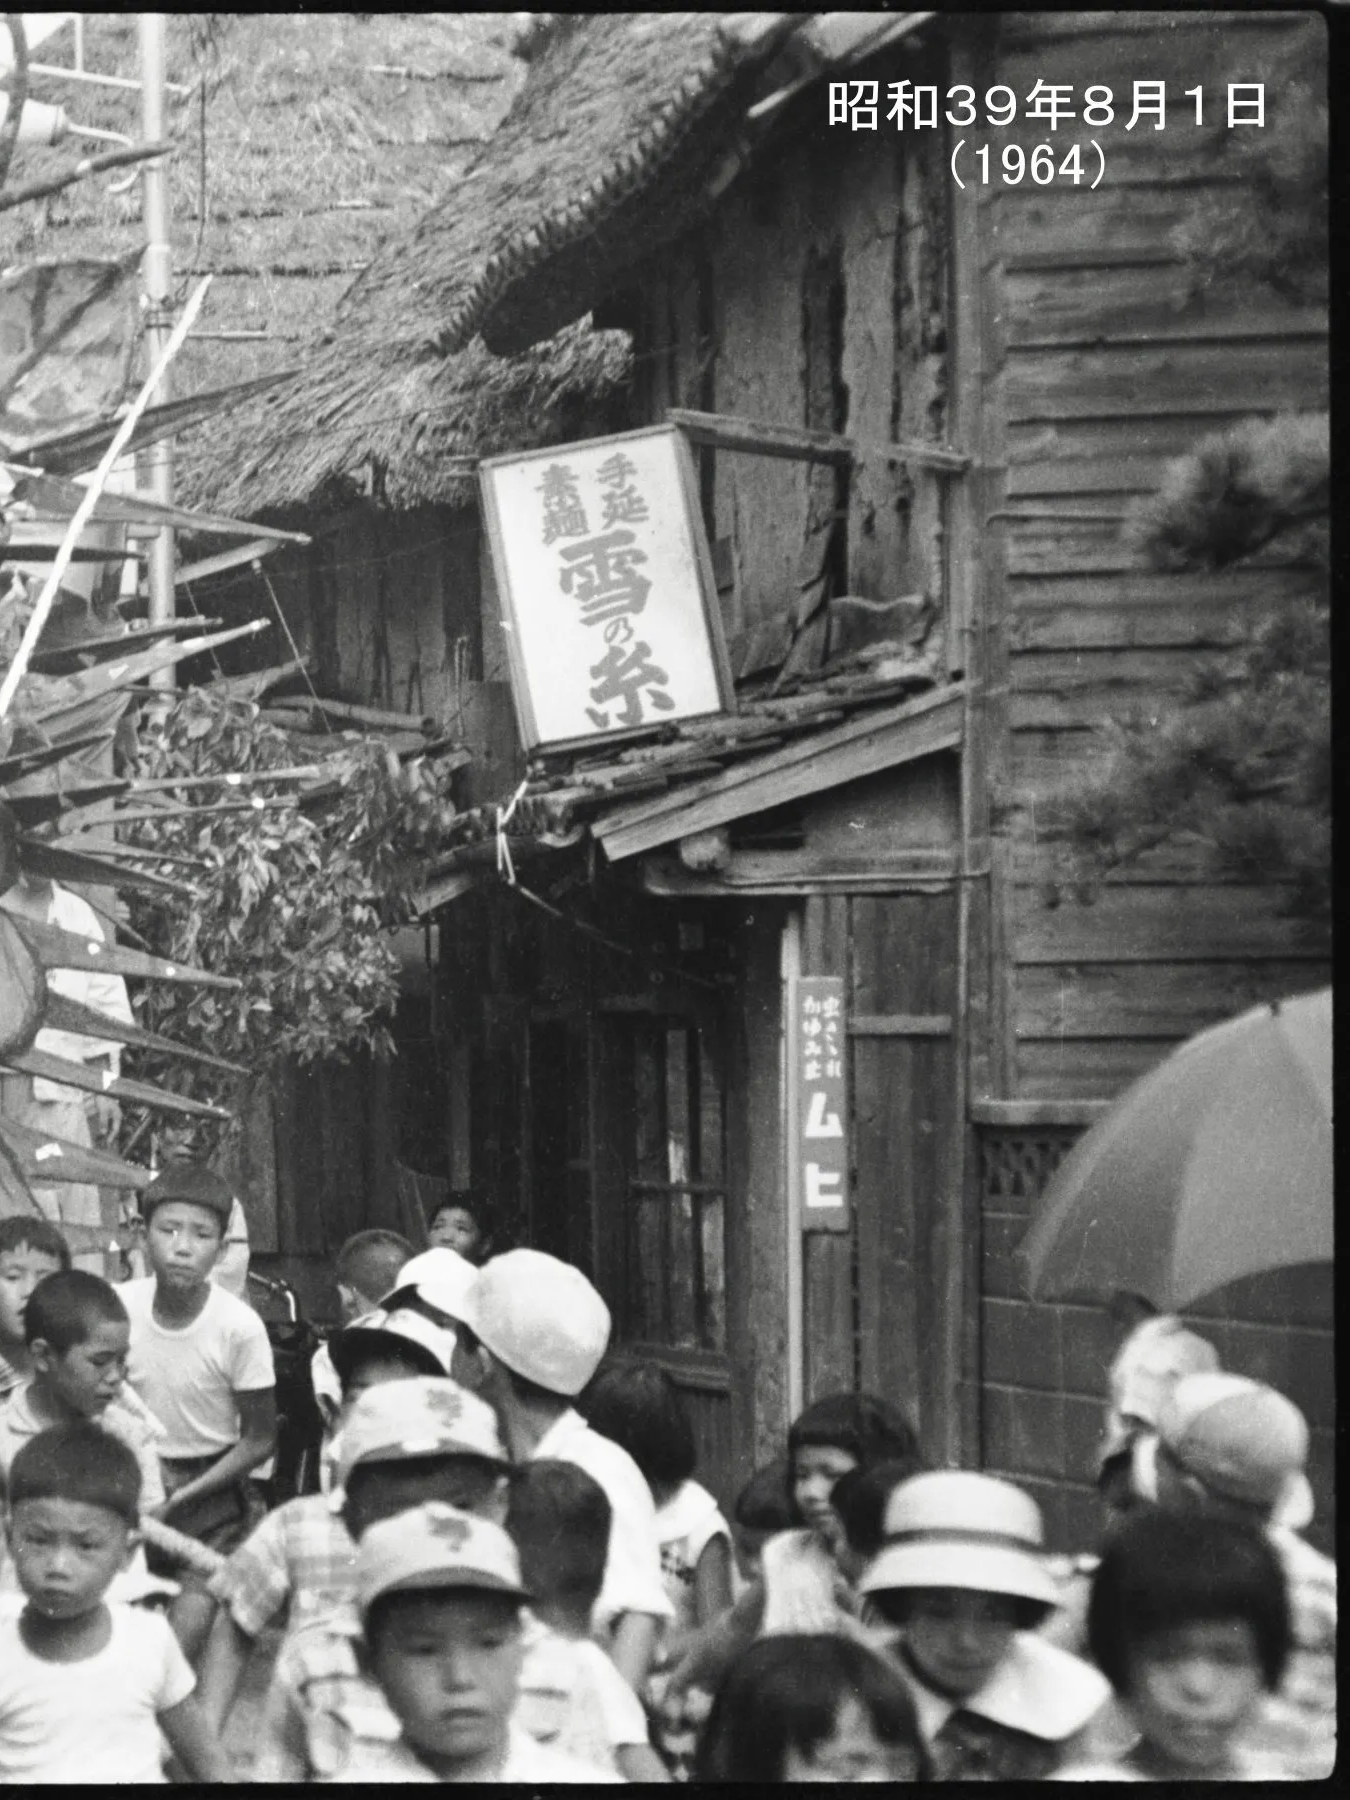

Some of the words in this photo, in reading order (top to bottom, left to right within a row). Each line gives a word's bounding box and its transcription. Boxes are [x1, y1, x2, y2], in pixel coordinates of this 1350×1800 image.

[596, 452, 650, 530] 手延
[558, 529, 676, 728] 雪の糸
[805, 1092, 844, 1208] ムヒ
